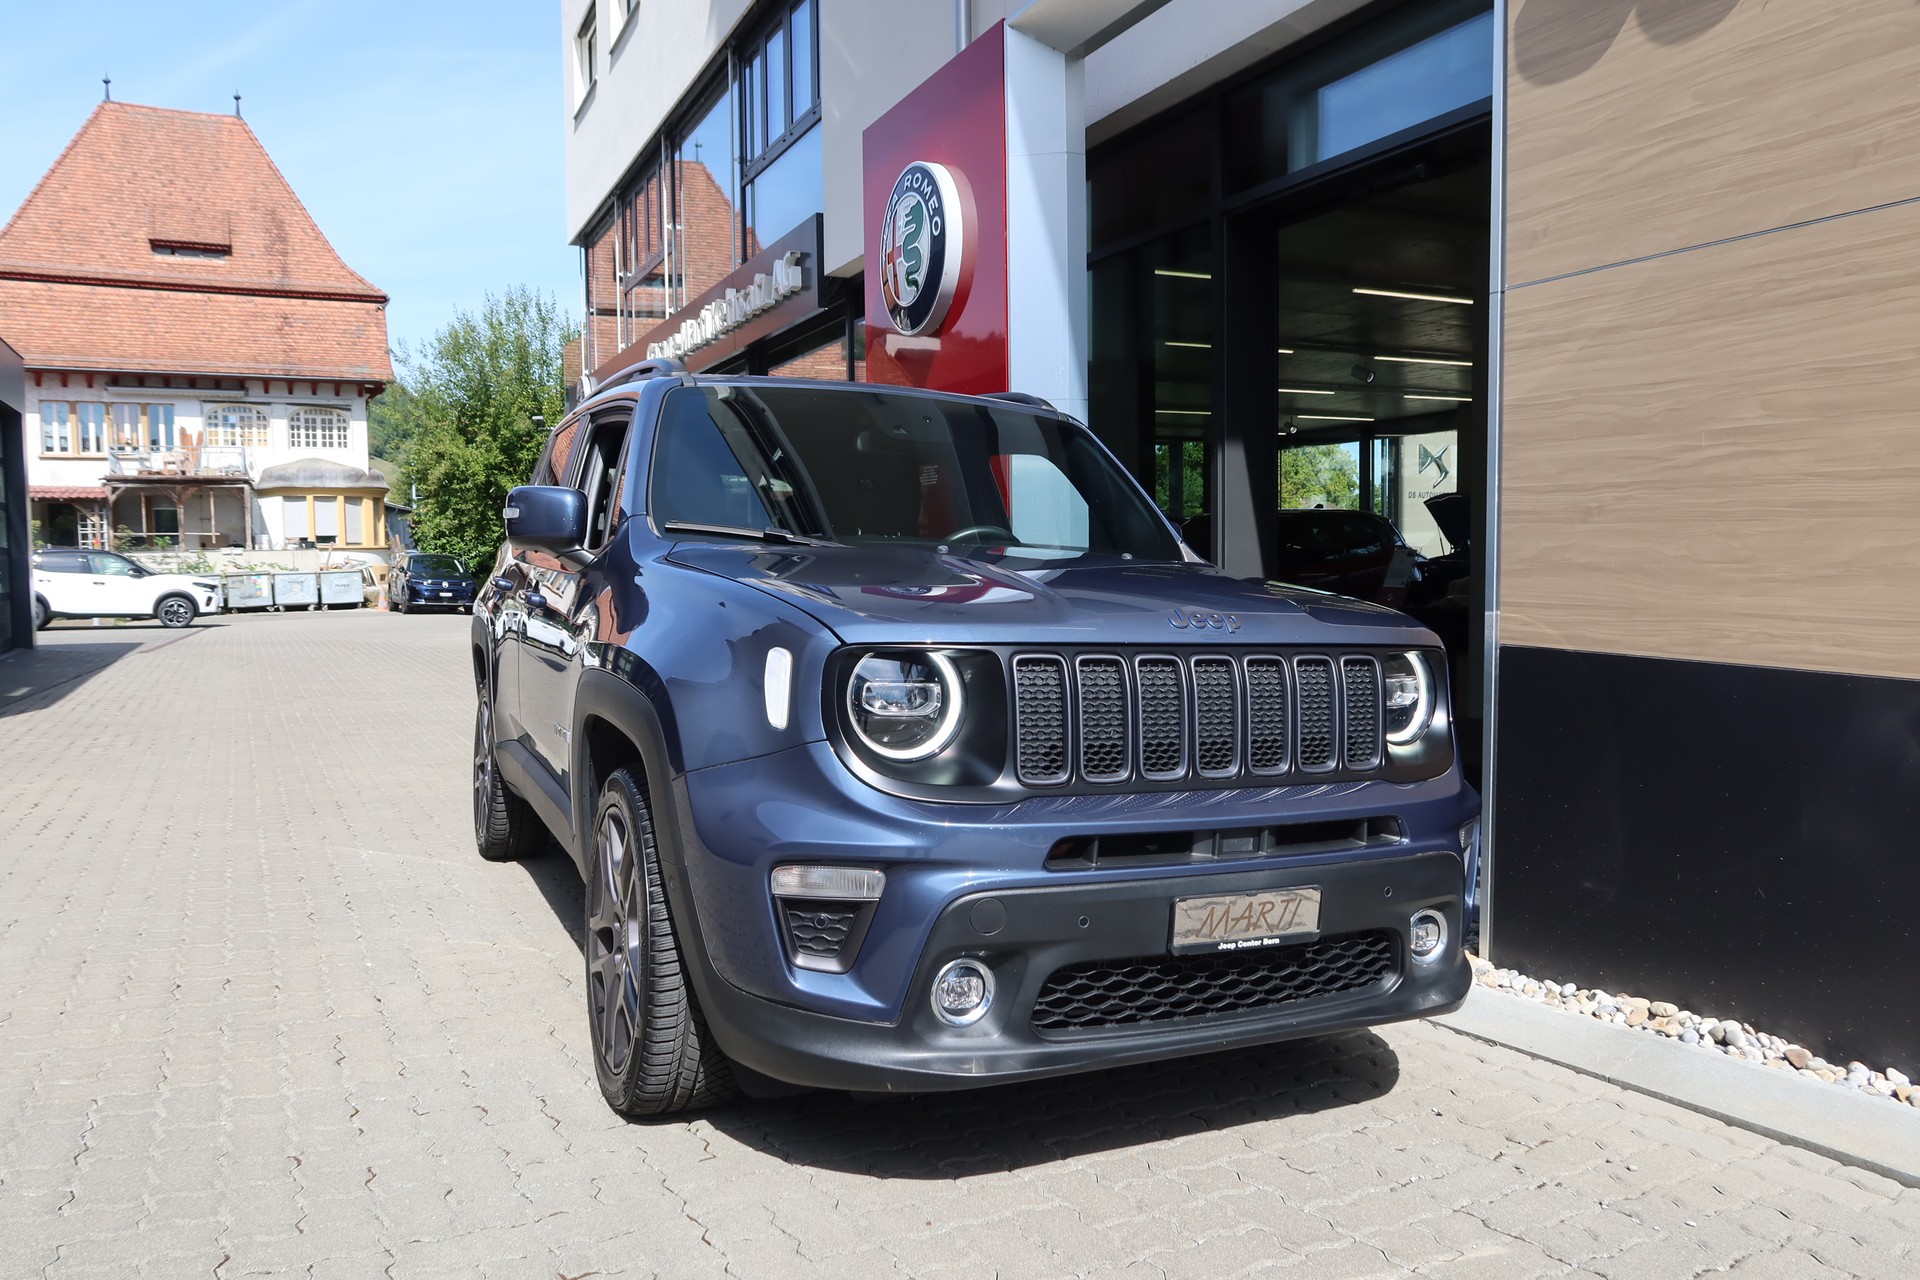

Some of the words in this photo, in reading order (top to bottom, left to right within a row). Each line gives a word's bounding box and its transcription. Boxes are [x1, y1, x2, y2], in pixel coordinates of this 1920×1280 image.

[903, 172, 941, 236] ROMEO
[771, 250, 802, 301] AG
[1168, 607, 1242, 634] Jeep
[1196, 897, 1302, 938] MARTI
[1218, 942, 1236, 950] Jeep
[1237, 940, 1262, 948] Center
